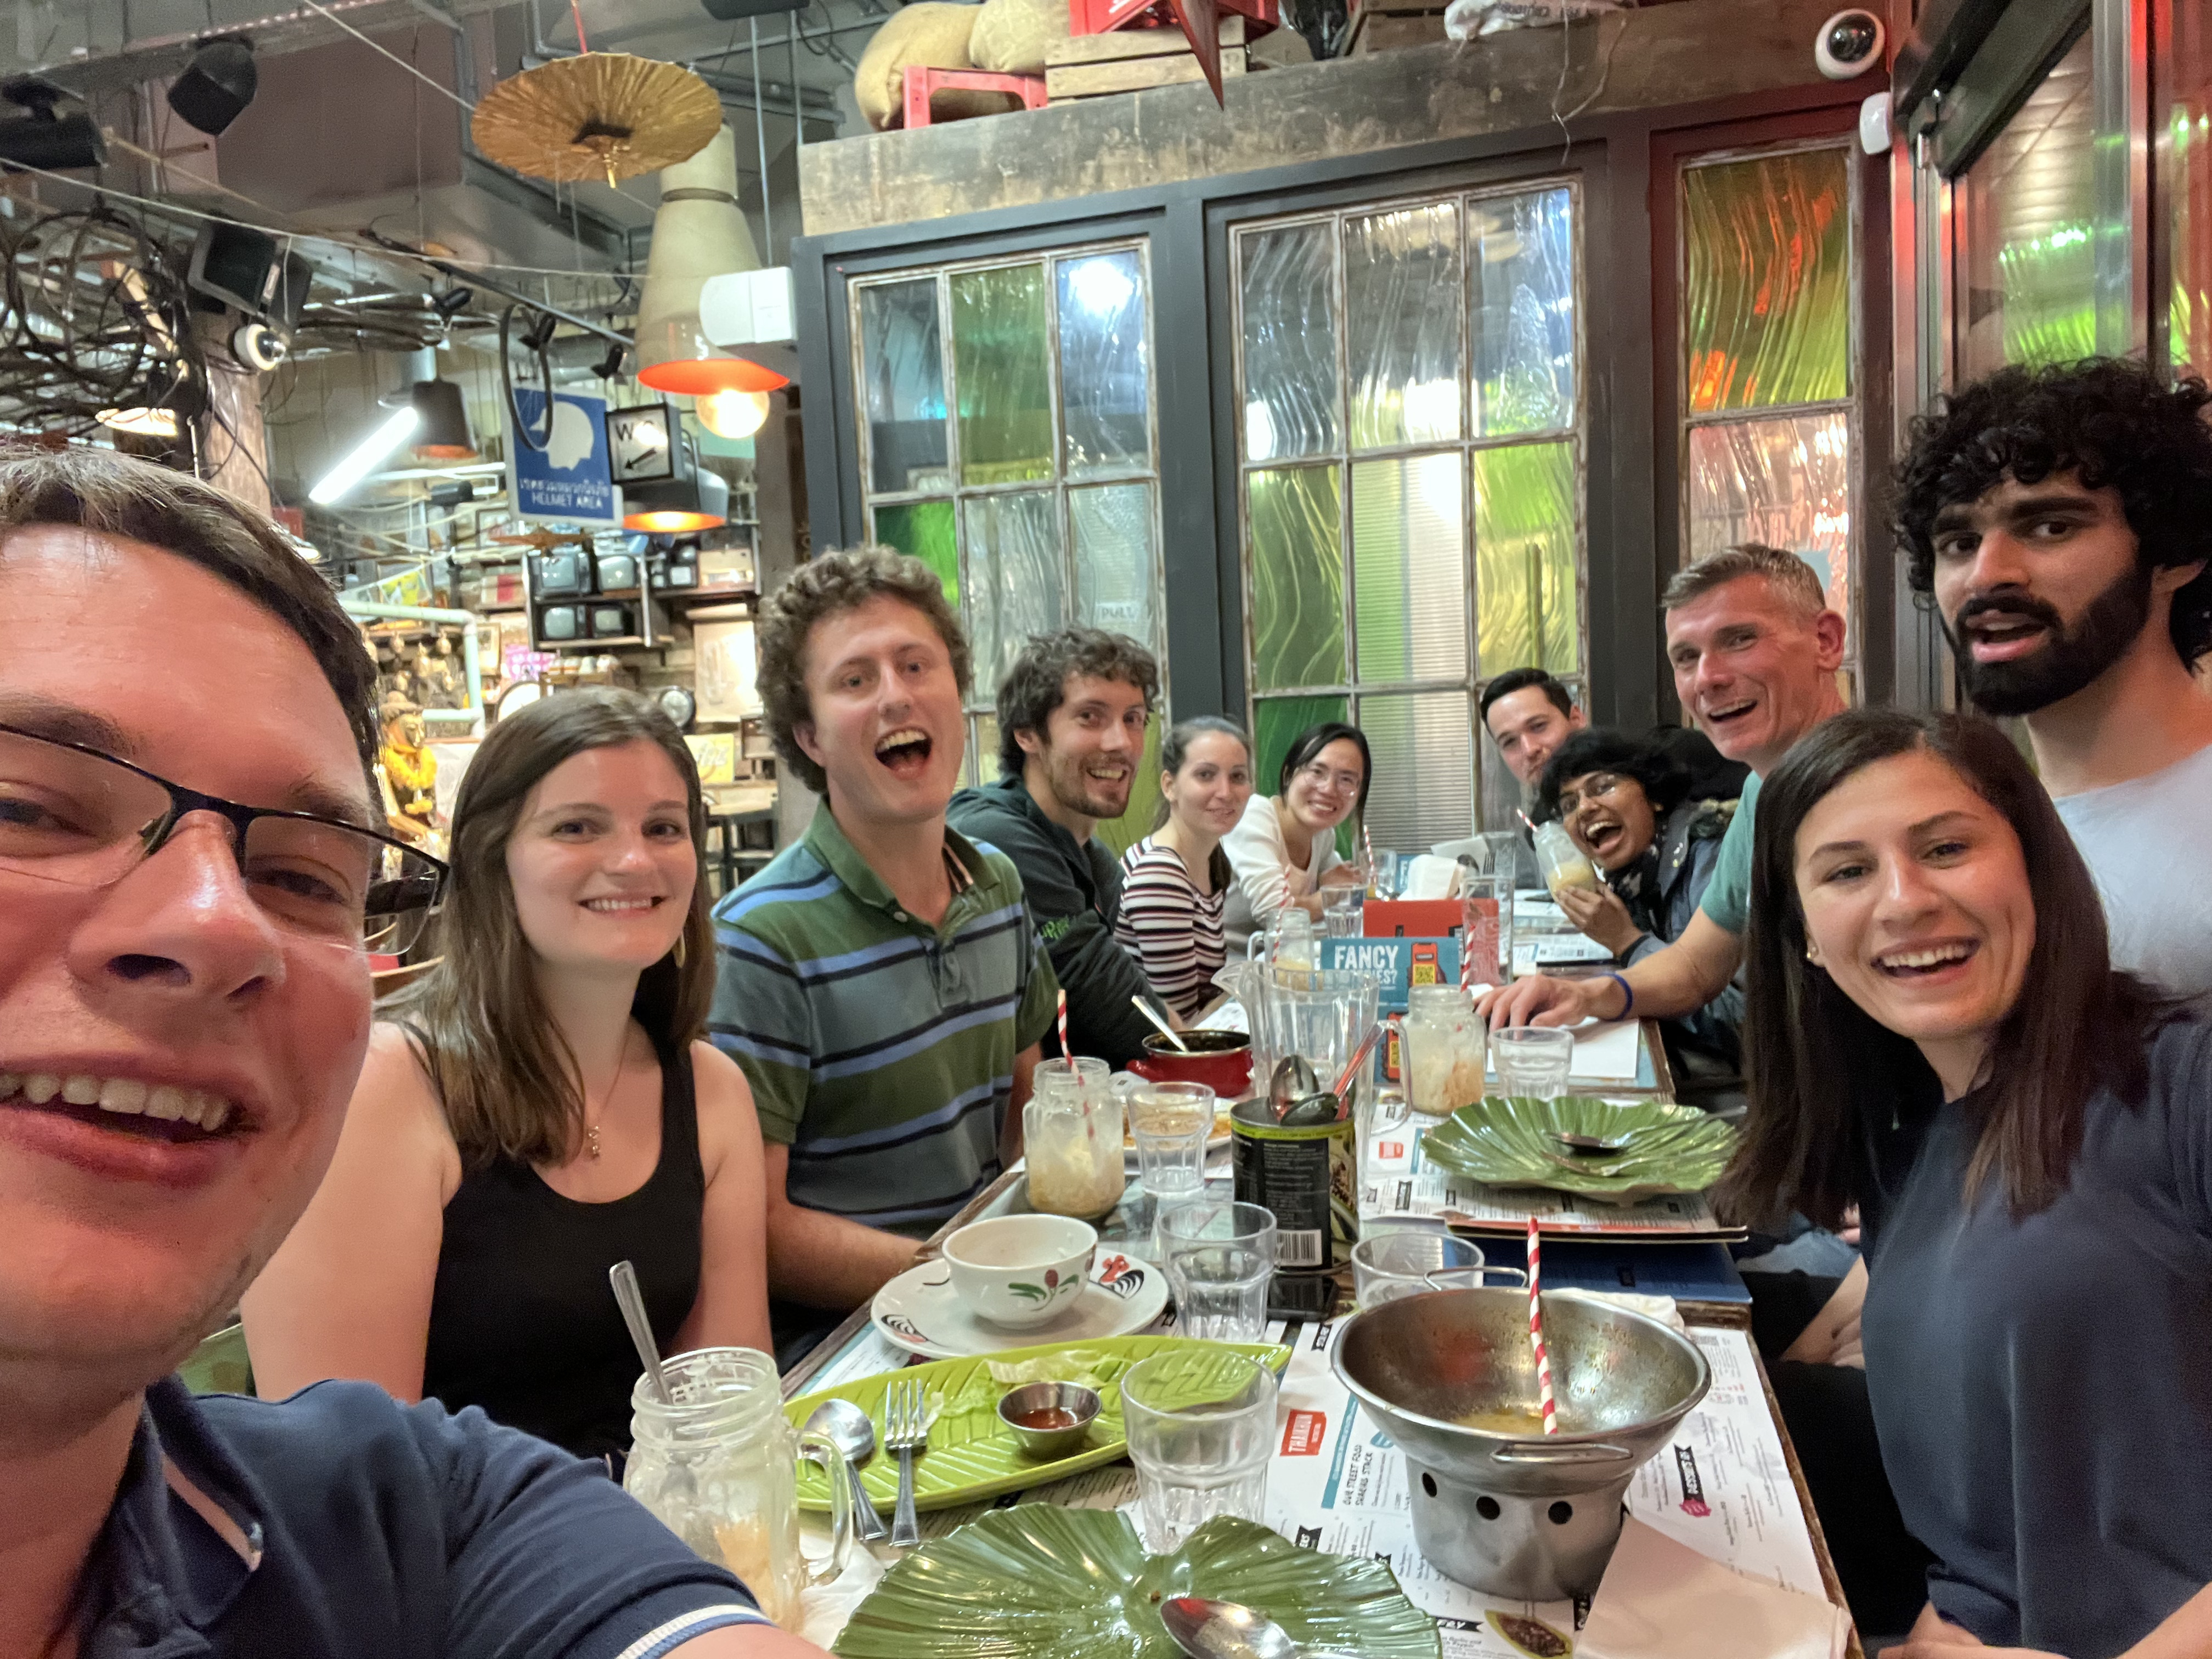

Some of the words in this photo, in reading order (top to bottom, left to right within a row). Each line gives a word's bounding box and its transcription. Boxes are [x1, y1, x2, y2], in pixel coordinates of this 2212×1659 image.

[532, 492, 572, 507] HELMET
[577, 495, 602, 509] AREA
[1334, 945, 1398, 970] FANCY
[1346, 1463, 1358, 1488] STREET
